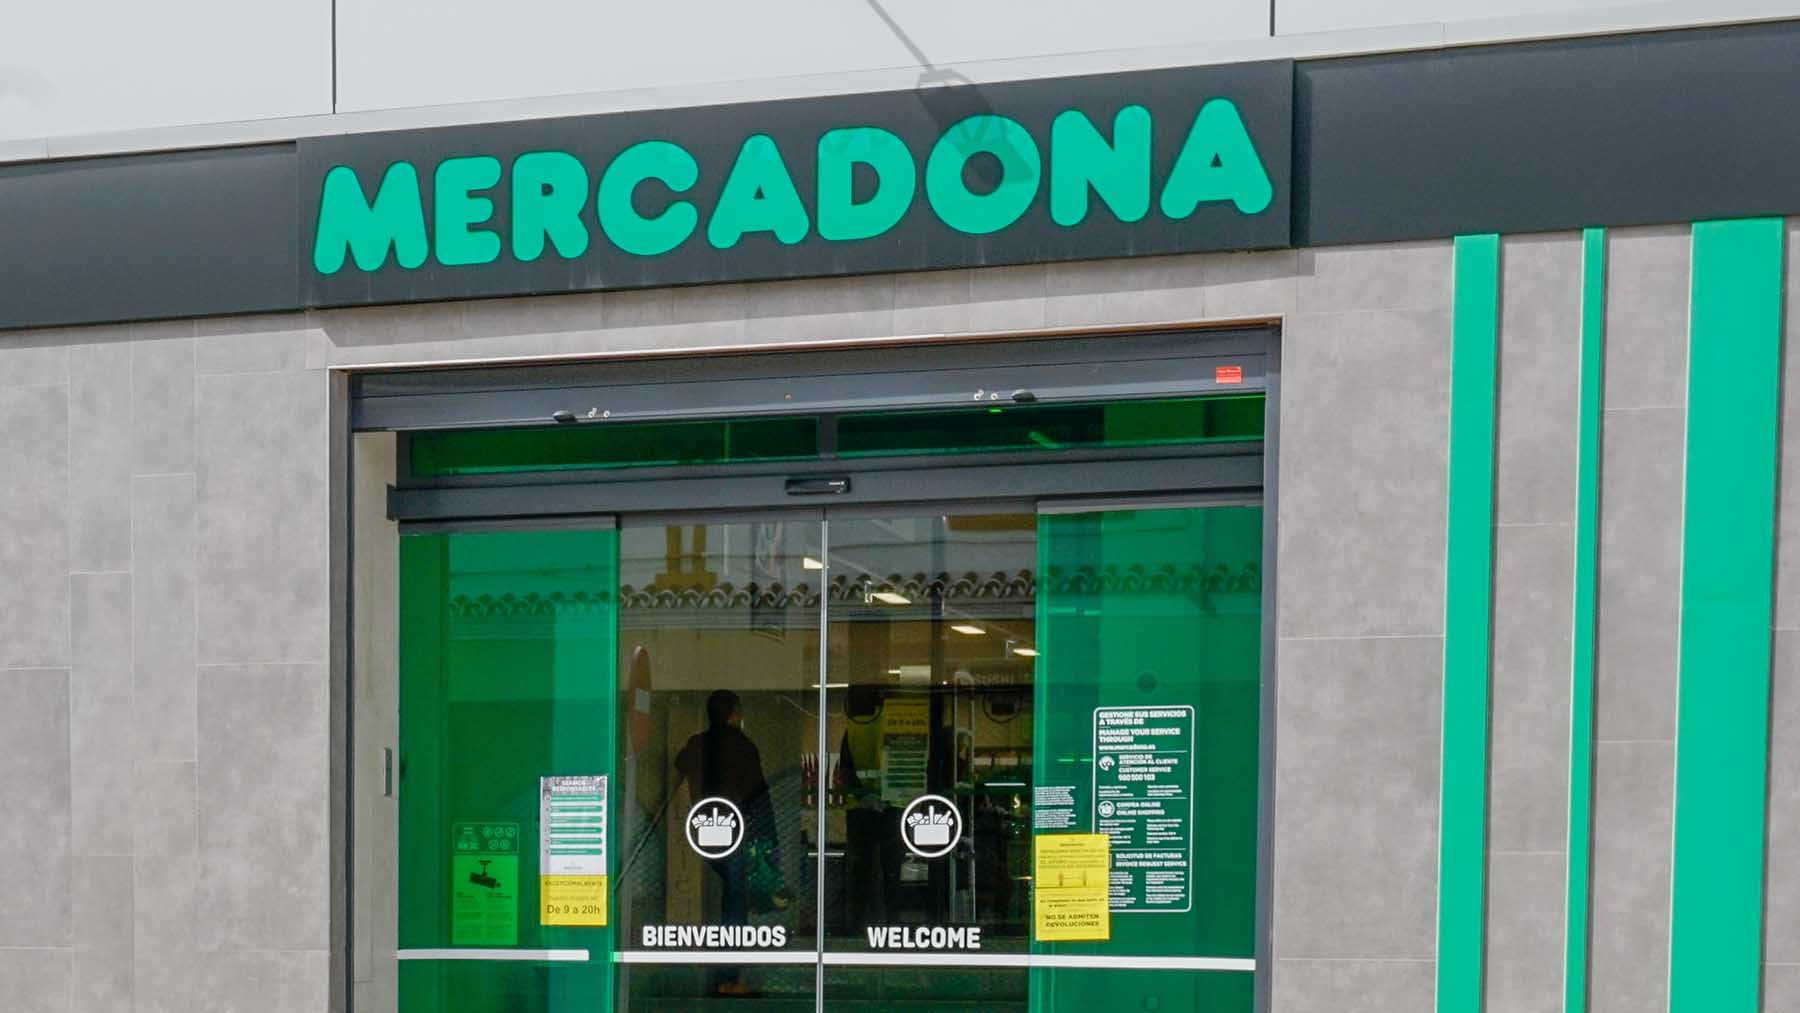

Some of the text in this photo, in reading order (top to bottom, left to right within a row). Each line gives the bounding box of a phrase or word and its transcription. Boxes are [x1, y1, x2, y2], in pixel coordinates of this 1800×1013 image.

[314, 97, 1273, 274] MERCADONA
[547, 904, 600, 915] De 9 a 20h
[642, 925, 786, 947] BIENVENIDOS
[867, 926, 981, 948] WELCOME
